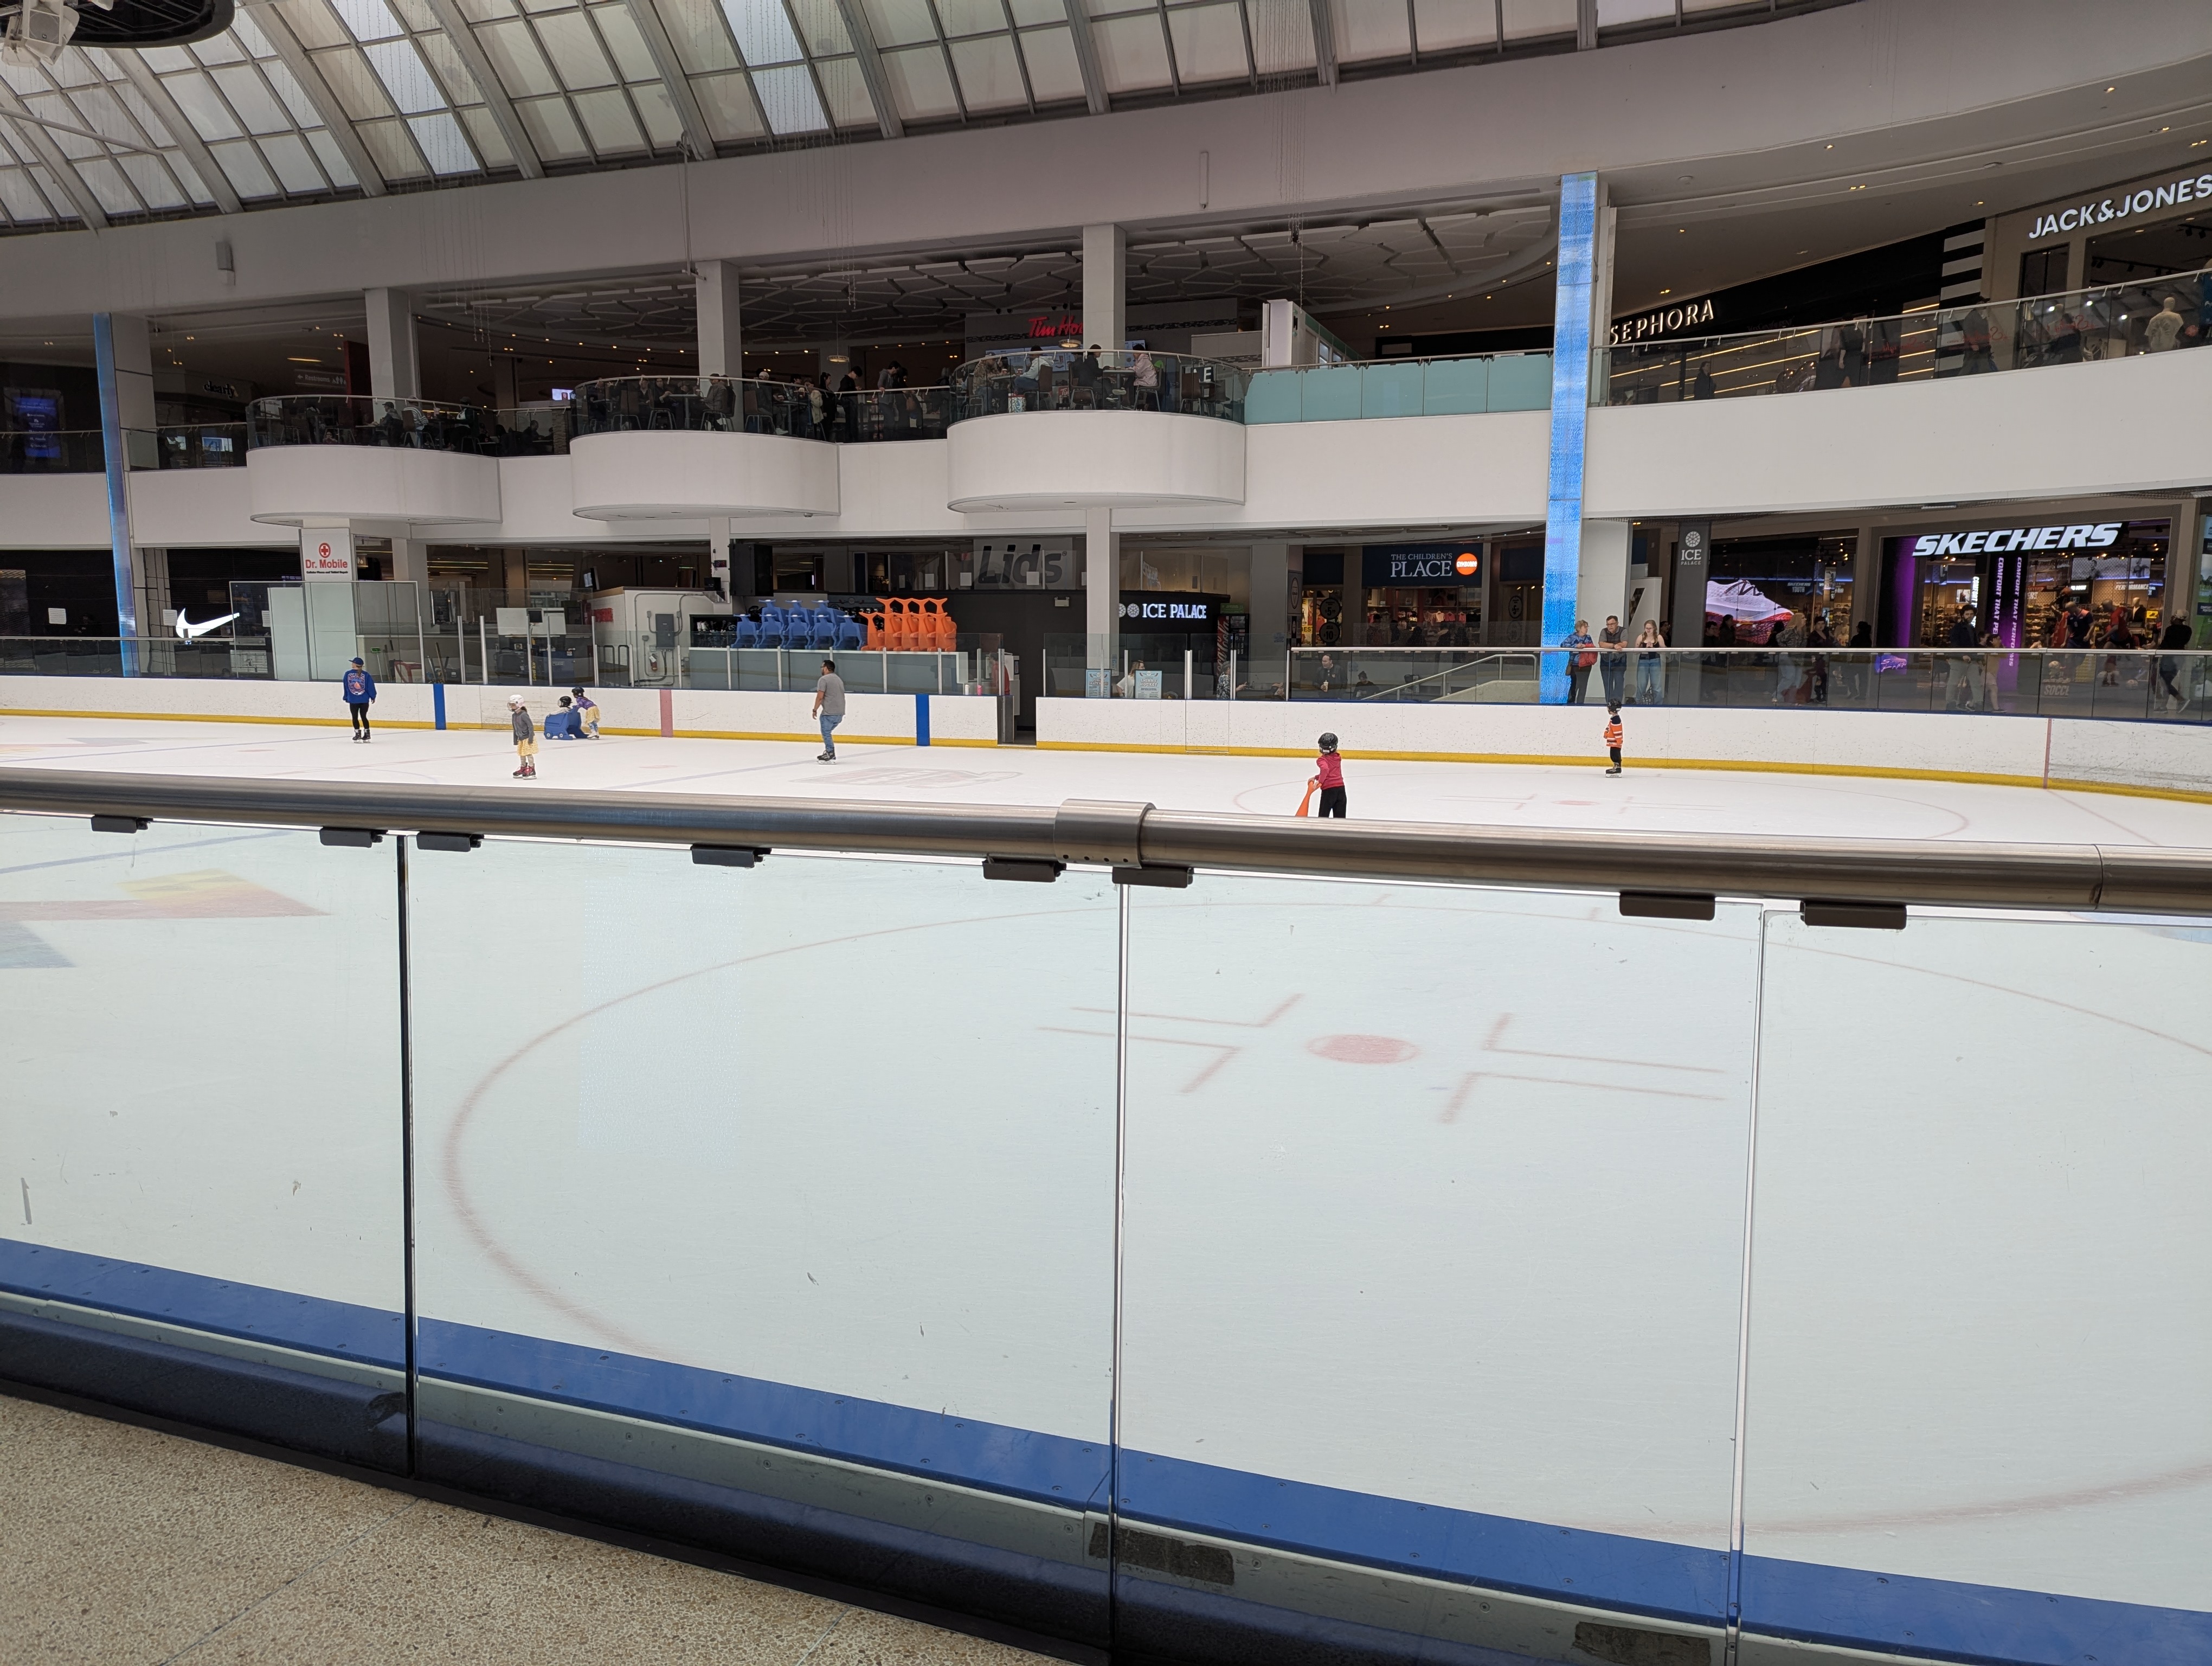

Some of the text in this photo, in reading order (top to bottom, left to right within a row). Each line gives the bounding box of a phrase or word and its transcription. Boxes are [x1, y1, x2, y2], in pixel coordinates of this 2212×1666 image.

[1028, 316, 1058, 338] Tim
[1609, 299, 1715, 345] SEPHORA
[305, 374, 330, 382] Restrooms
[203, 380, 237, 399] clearly
[1912, 522, 2123, 557] SKECHERS
[305, 559, 348, 568] Dr. Mobile
[978, 543, 1063, 584] Lids
[1681, 549, 1702, 561] ICE
[1390, 560, 1453, 578] PLACE
[1995, 557, 2005, 597] COMFORT
[2014, 556, 2023, 597] COMFORT
[1142, 603, 1207, 619] ICE PALACE
[1993, 598, 2002, 620] THAT
[1217, 617, 1230, 675] oca-Cola
[2009, 622, 2017, 667] PERFOMS
